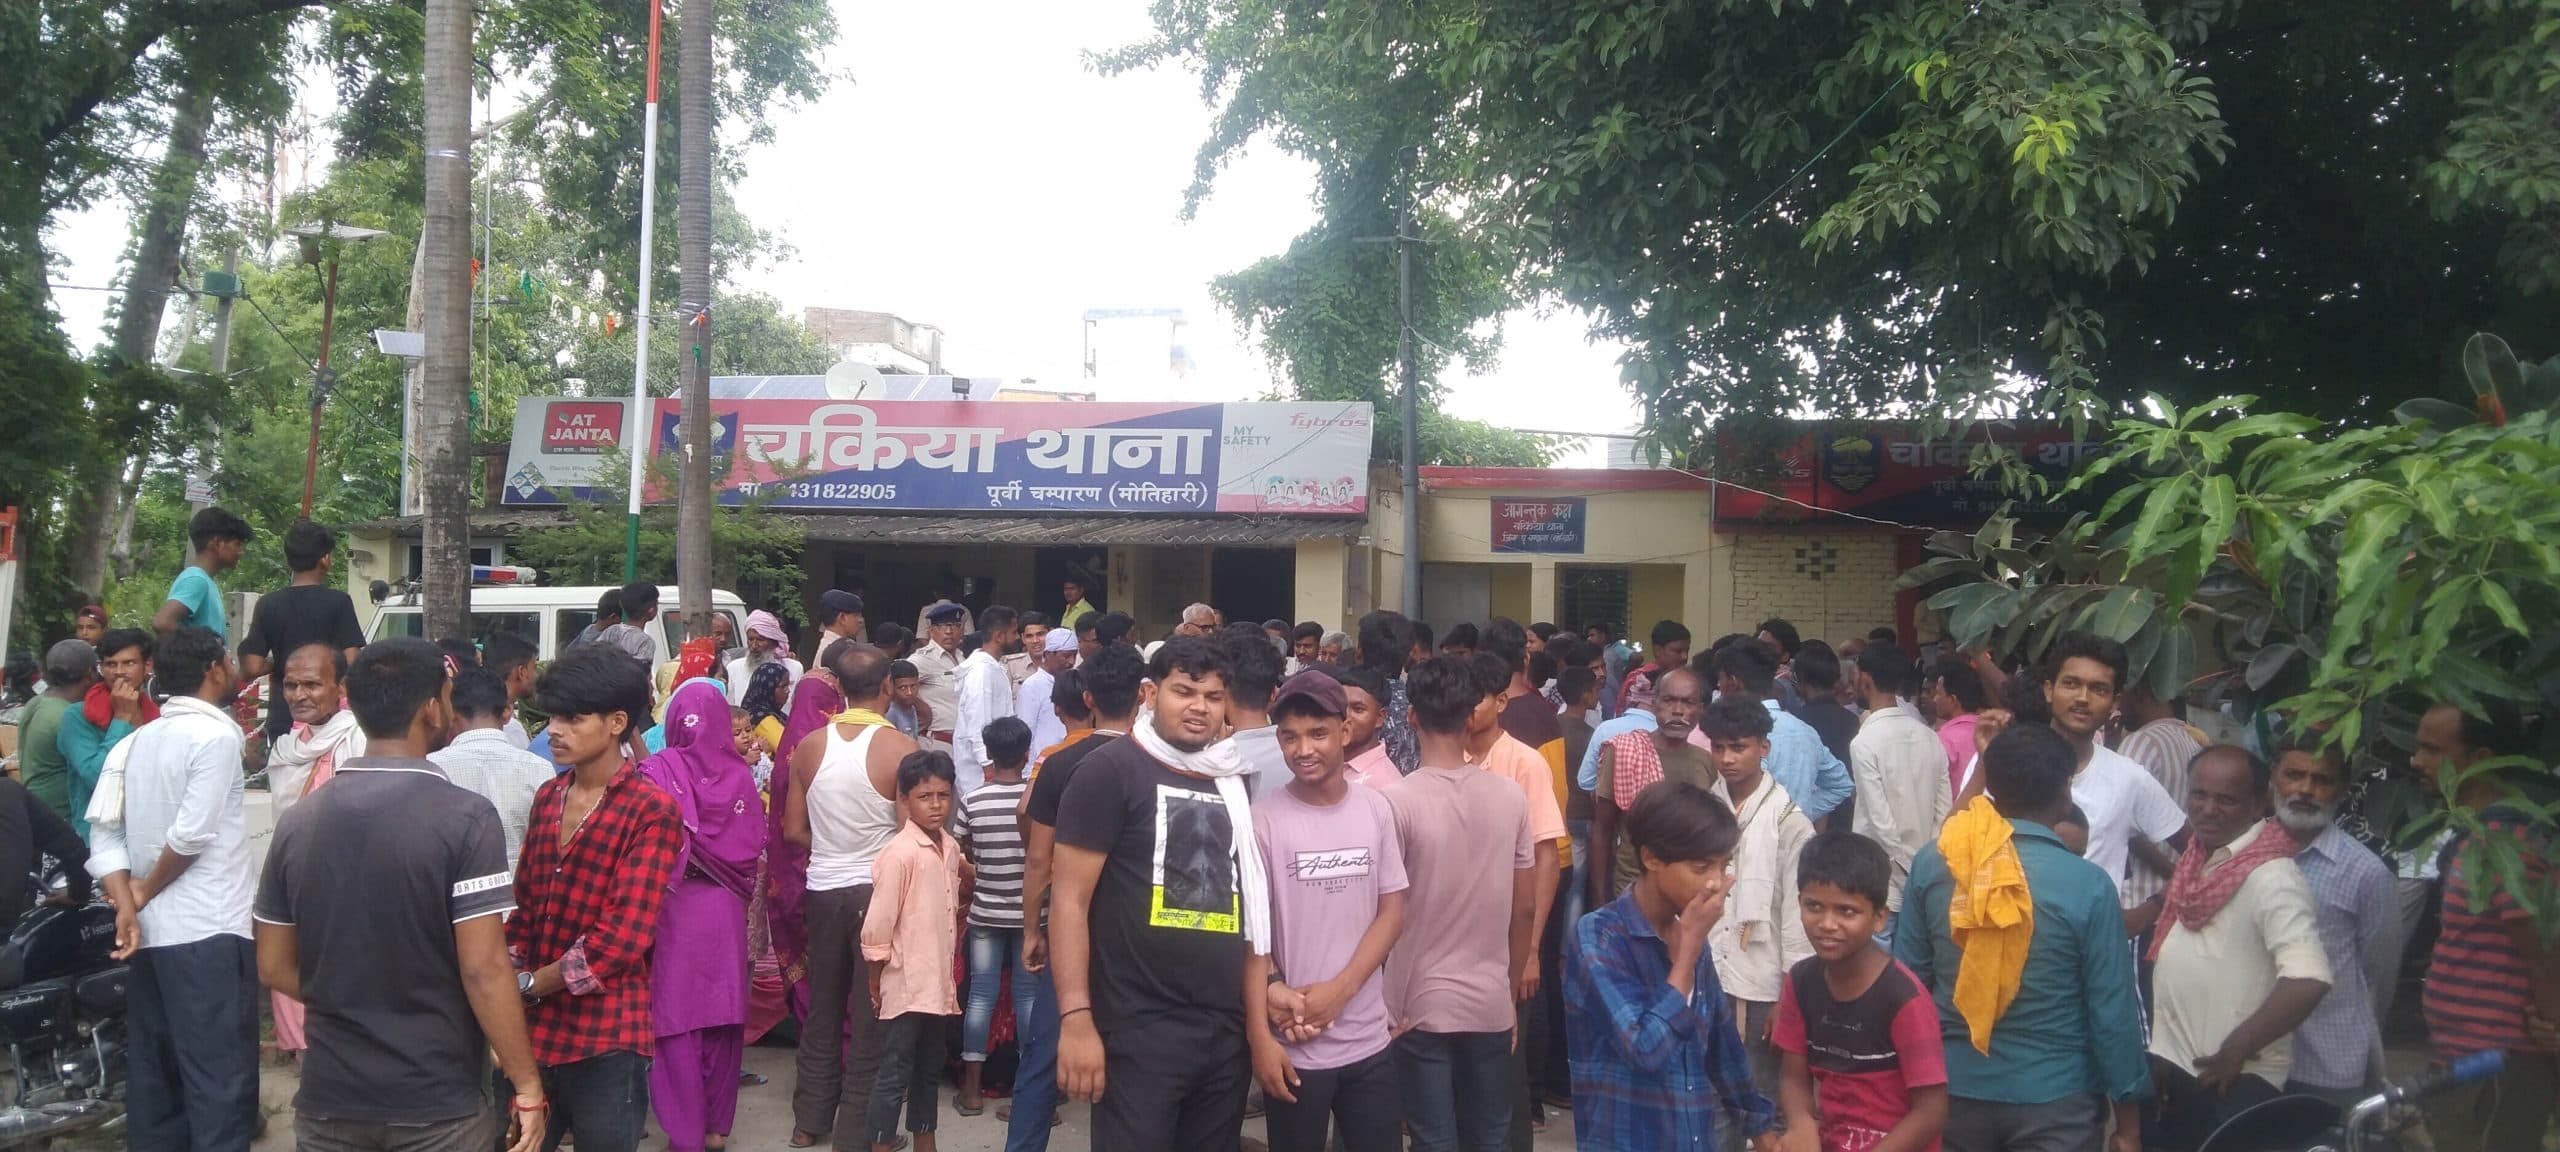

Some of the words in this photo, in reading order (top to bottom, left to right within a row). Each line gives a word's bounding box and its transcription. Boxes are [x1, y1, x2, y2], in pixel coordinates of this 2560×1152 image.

[550, 428, 612, 441] JANTA
[1234, 426, 1254, 435] MY
[742, 404, 1004, 473] चकिया
[1026, 428, 1212, 475] थाना
[1223, 436, 1271, 446] SAFETY
[774, 483, 896, 500] 431822905
[986, 480, 1022, 507] पूर्वी
[1029, 485, 1102, 502] चम्पारण
[1108, 481, 1208, 508] (मोतिहारी)
[1286, 854, 1376, 877] Authentic
[92, 922, 114, 937] Hero
